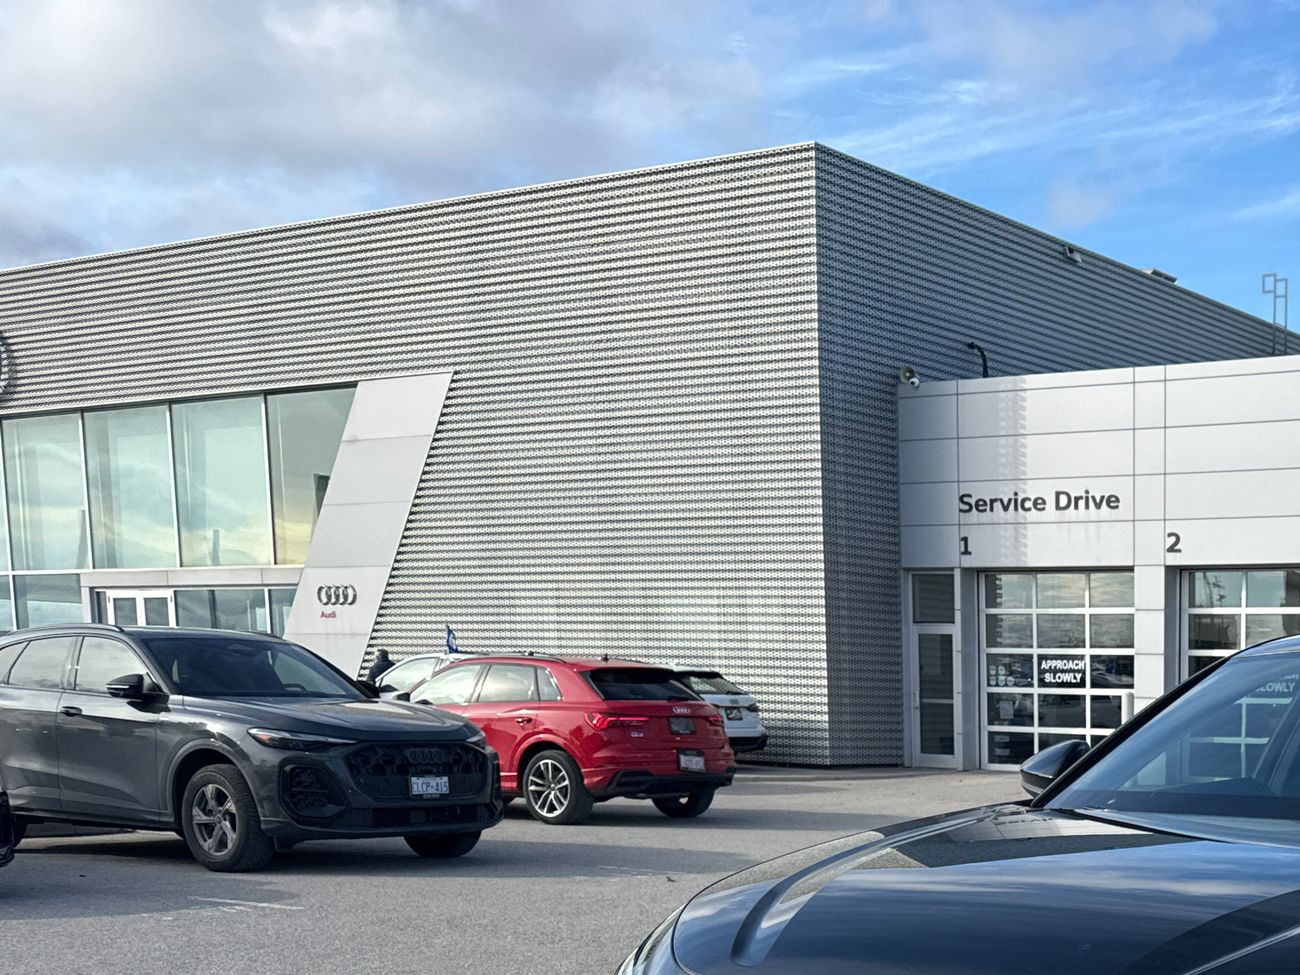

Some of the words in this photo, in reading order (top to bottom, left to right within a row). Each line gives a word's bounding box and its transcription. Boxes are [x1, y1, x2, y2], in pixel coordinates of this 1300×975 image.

[958, 492, 1047, 514] Service
[1054, 489, 1121, 511] Drive
[960, 536, 972, 556] 1
[1166, 533, 1182, 553] 2
[1041, 660, 1085, 670] APPROACH
[1044, 673, 1082, 683] SLOWLY
